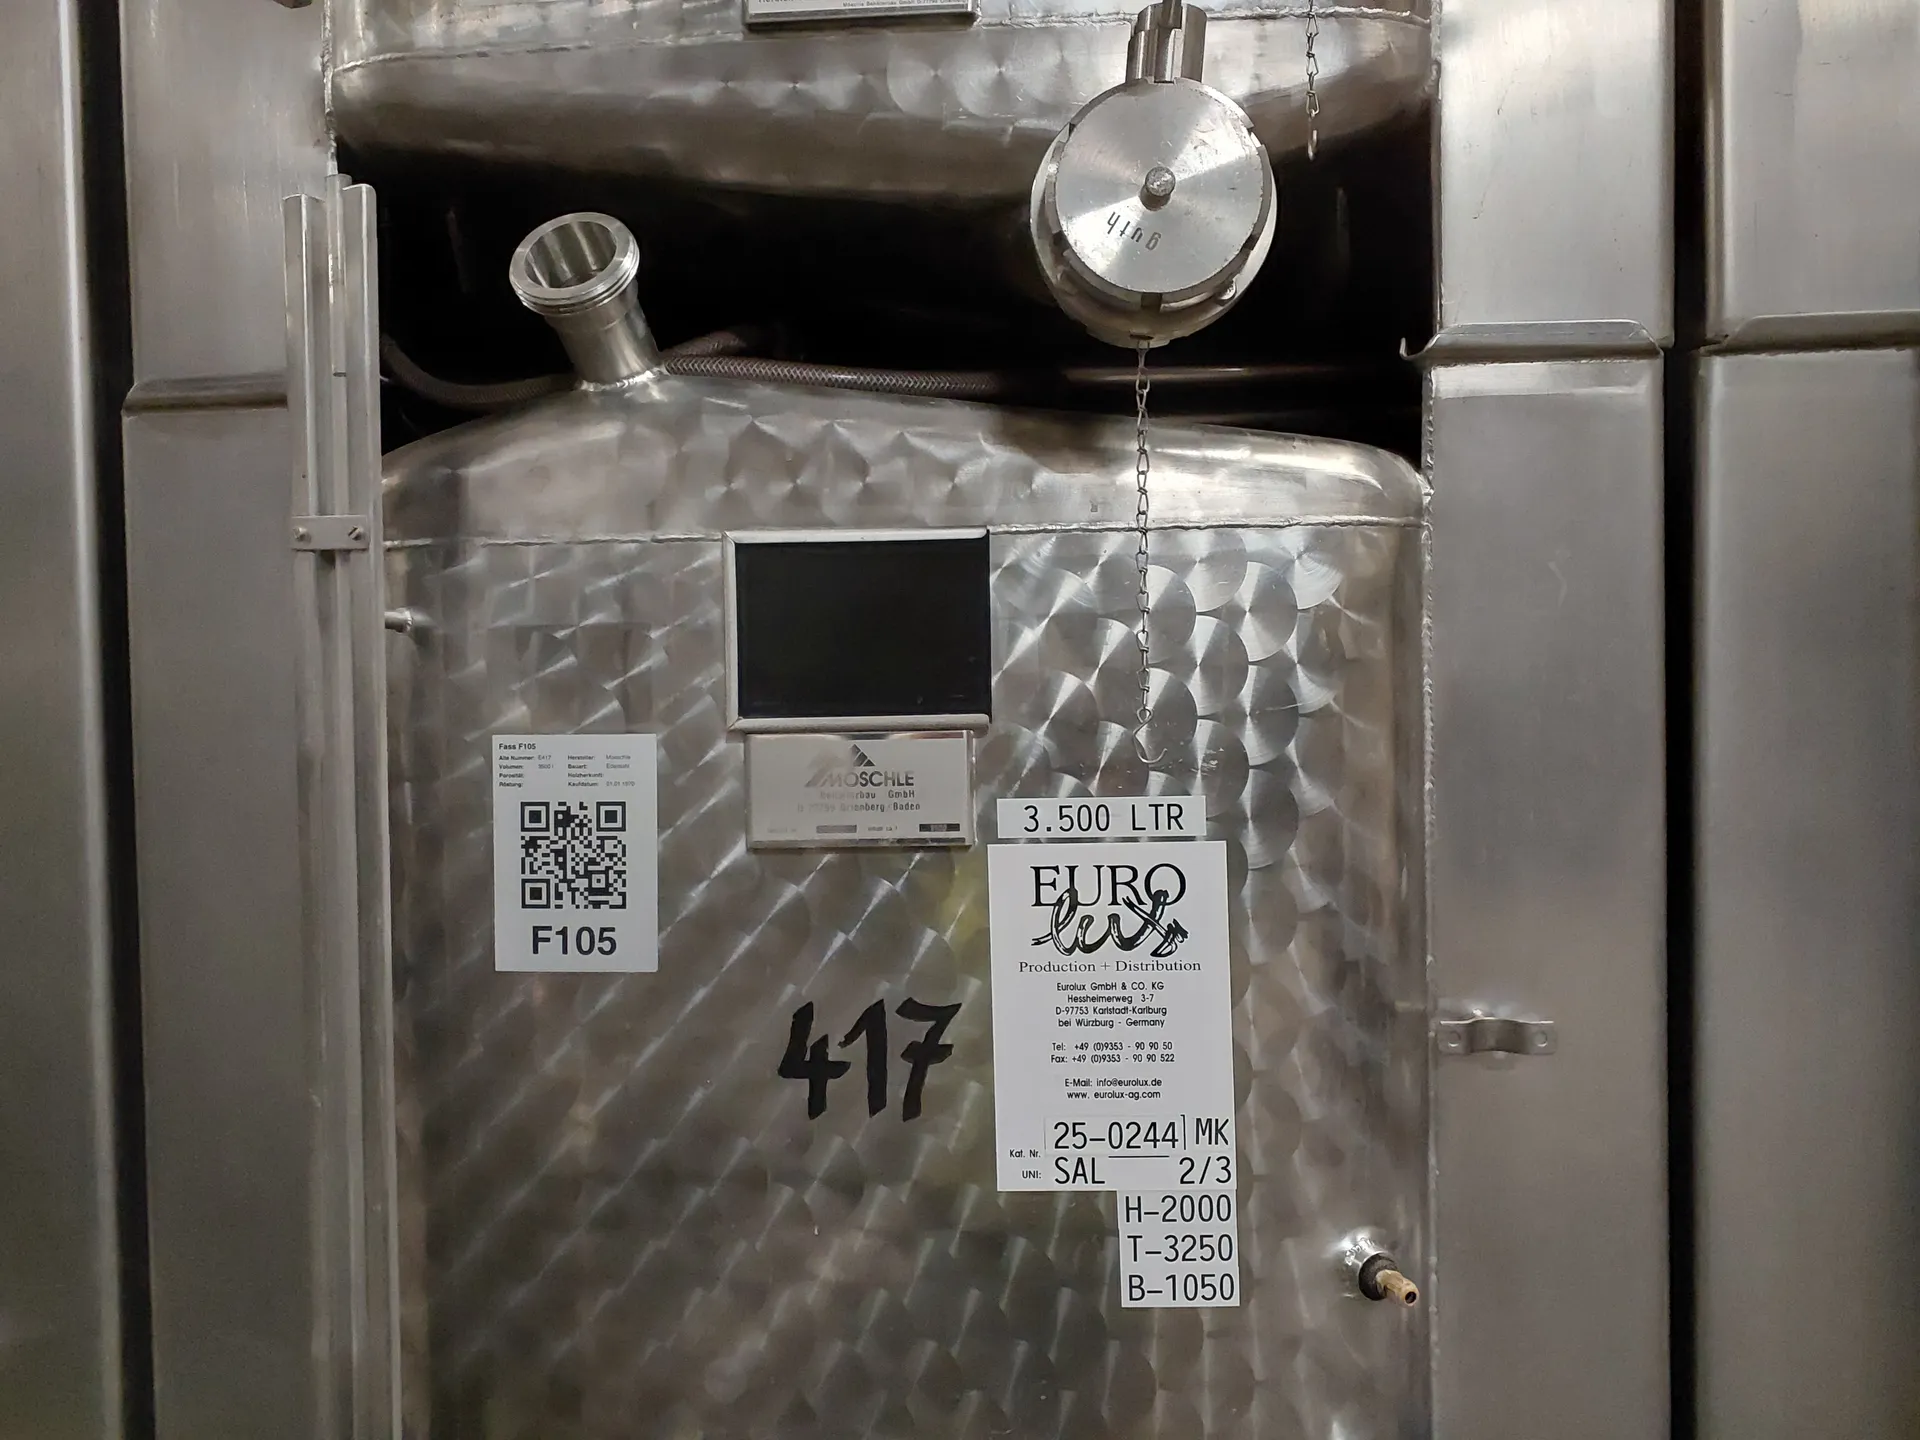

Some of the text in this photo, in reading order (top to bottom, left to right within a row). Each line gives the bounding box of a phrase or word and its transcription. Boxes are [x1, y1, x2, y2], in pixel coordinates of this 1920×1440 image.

[888, 790, 915, 799] GmbH
[893, 801, 920, 811] Baden
[1024, 803, 1184, 832] 3.500 LTR
[1030, 863, 1187, 907] EURO
[1031, 888, 1190, 958] lux
[532, 925, 617, 956] F105
[1019, 960, 1202, 973] Production + Distribution
[1056, 981, 1165, 991] Eurolux GmbH & CO. KG
[1067, 994, 1155, 1004] Hessheimerweg 3-7
[1055, 1005, 1168, 1016] D-97753 Karlstadt-Karlburg
[1058, 1018, 1072, 1027] bei
[1075, 1018, 1114, 1029] Würzburg
[1125, 1018, 1165, 1028] Germany
[1052, 1042, 1066, 1051] Tel:
[1074, 1042, 1089, 1051] +49
[1093, 1042, 1124, 1052] (0)9353
[1135, 1042, 1145, 1050] 90
[1149, 1042, 1159, 1050] 90
[1162, 1041, 1173, 1050] 50
[777, 996, 963, 1123] 417
[1050, 1054, 1068, 1063] Fax:
[1072, 1054, 1087, 1063] +49
[1091, 1054, 1121, 1064] (0)9353
[1132, 1054, 1143, 1063] 90
[1146, 1054, 1157, 1063] 90
[1160, 1054, 1175, 1062] 522
[1064, 1078, 1162, 1087] E-Mail: info@eurolux.de
[1067, 1090, 1161, 1100] www. eurolux-ag.com
[1053, 1118, 1230, 1149] 25-0244 MK
[1009, 1149, 1041, 1158] Kat. Nr.
[1022, 1156, 1232, 1185] UNI: SAL 2/3
[1125, 1194, 1232, 1222] H-2000
[1127, 1234, 1234, 1262] T-3250
[1128, 1273, 1235, 1301] B-1050
